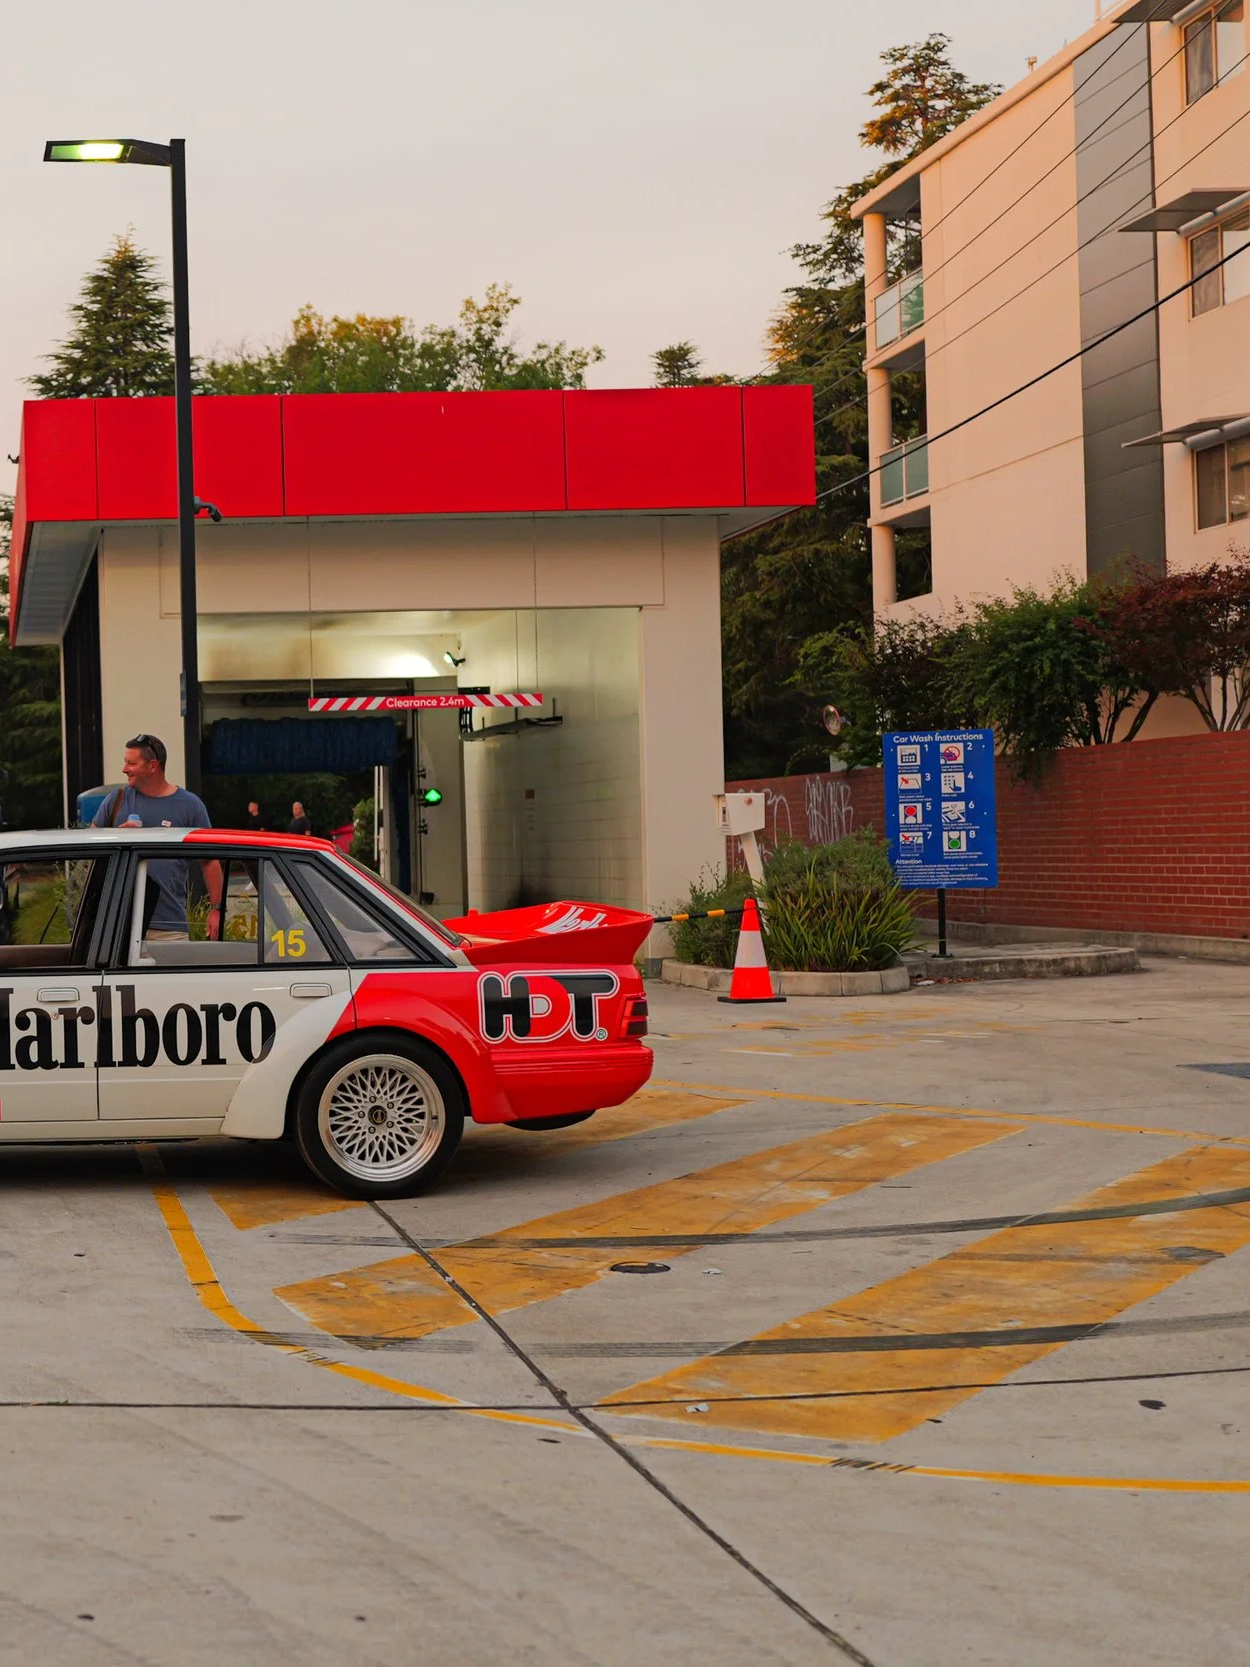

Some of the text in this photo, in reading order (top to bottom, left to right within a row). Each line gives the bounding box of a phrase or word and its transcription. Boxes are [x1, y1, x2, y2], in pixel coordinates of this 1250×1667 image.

[386, 696, 465, 708] Clearance 2.4m
[893, 732, 984, 744] Car Wash Instructions
[924, 744, 929, 752] 1
[967, 742, 973, 750] 2
[924, 773, 931, 781] 3
[967, 771, 974, 779] 4
[925, 802, 932, 811] 5
[968, 801, 975, 809] 6
[926, 831, 933, 840] 7
[969, 830, 976, 838] 8
[270, 929, 306, 958] 15
[480, 973, 617, 1041] HDT
